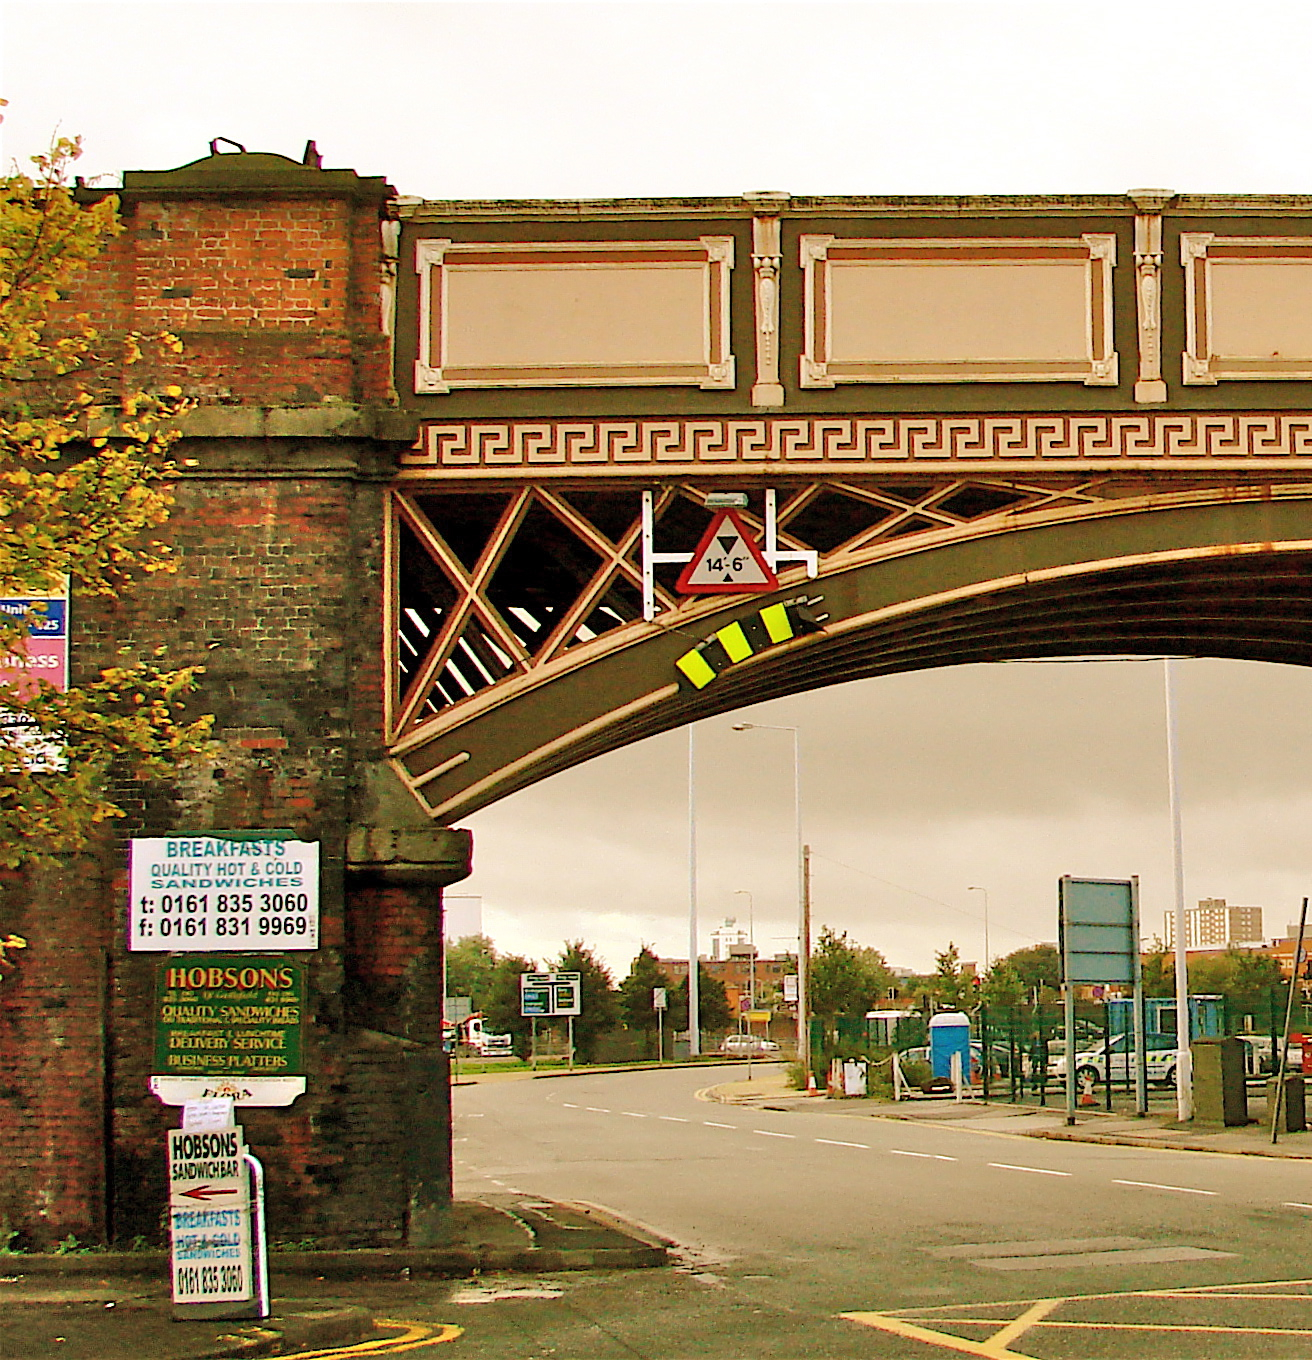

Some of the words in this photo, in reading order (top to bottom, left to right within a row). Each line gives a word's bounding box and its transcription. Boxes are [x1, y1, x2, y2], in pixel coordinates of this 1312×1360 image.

[167, 841, 285, 857] BREAKFASTS
[151, 863, 212, 877] QUALITY
[217, 862, 246, 876] HOT
[251, 862, 260, 876] &
[265, 861, 303, 875] COLD
[151, 877, 303, 889] SANDWICHES
[141, 896, 155, 913] t:
[162, 895, 208, 914] 0161
[217, 894, 253, 913] 835
[260, 893, 308, 912] 3060
[139, 918, 153, 936] f:
[160, 918, 207, 937] 0161
[216, 917, 249, 936] 831
[259, 916, 307, 936] 9969
[162, 1005, 214, 1017] QUALITY
[219, 1005, 299, 1017] SANDWICHES
[169, 1037, 229, 1049] DELIVERY
[233, 1038, 287, 1049] SERVICE
[168, 1054, 226, 1067] BUSINESS
[229, 1055, 288, 1067] PLATTERS
[173, 1132, 238, 1160] HOBSONS
[173, 1209, 240, 1229] BREAKFASTS
[177, 1267, 200, 1295] 0161
[202, 1265, 219, 1294] 835
[221, 1264, 243, 1293] 3060
